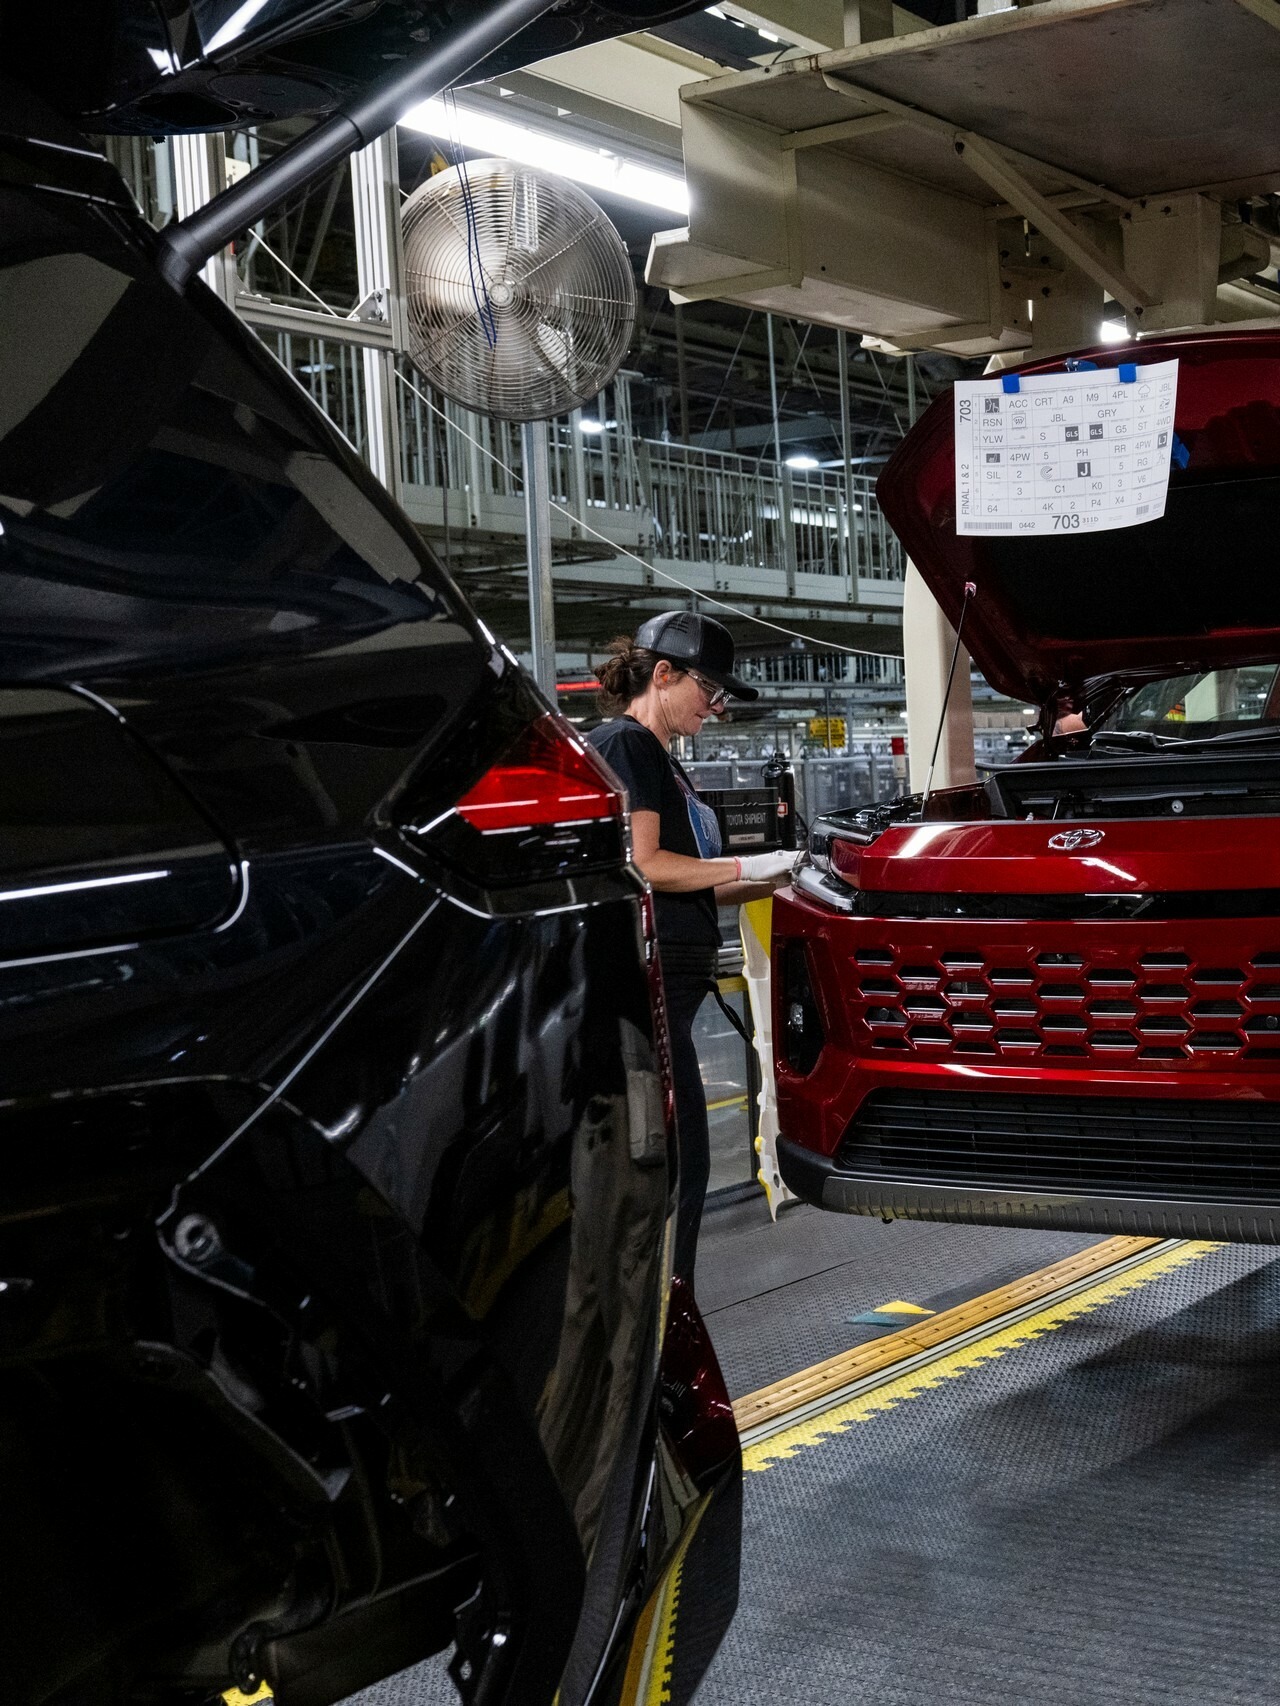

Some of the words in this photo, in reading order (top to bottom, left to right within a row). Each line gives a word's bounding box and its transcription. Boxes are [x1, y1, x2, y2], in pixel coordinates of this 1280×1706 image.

[1008, 400, 1028, 408] ACC
[1034, 397, 1053, 406] CRT
[1062, 396, 1074, 404] A9
[1086, 393, 1099, 402] M9
[1112, 390, 1128, 400] 4PL
[1159, 384, 1172, 392] JBL
[959, 399, 972, 423] 703
[983, 419, 1003, 427] RSN
[1051, 414, 1066, 423] JBL
[1097, 409, 1117, 418] GRY
[1140, 405, 1145, 413] X
[1040, 432, 1046, 440] S
[1090, 428, 1103, 436] GLS
[1116, 425, 1127, 434] G5
[1138, 422, 1147, 430] ST
[1156, 416, 1171, 426] 4WD
[1010, 453, 1030, 461] 4PW
[1043, 452, 1049, 460] 5
[1076, 448, 1088, 457] PH
[1114, 445, 1126, 453] RR
[1135, 440, 1151, 449] 4PW
[986, 472, 1001, 480] SIL
[1016, 470, 1022, 478] 2
[1080, 463, 1088, 476] J
[1119, 462, 1124, 470] 5
[1137, 458, 1148, 467] RG
[1054, 485, 1066, 493] C1
[1118, 479, 1122, 487] 3
[1138, 475, 1146, 484] V6
[1042, 503, 1054, 511] 4K
[1070, 501, 1075, 509] 2
[1091, 500, 1101, 508] P4
[1115, 496, 1124, 504] X4
[1138, 493, 1142, 501] 3
[1052, 514, 1080, 529] 703
[726, 814, 743, 826] TOYOTA
[744, 812, 766, 824] SHIPMENT
